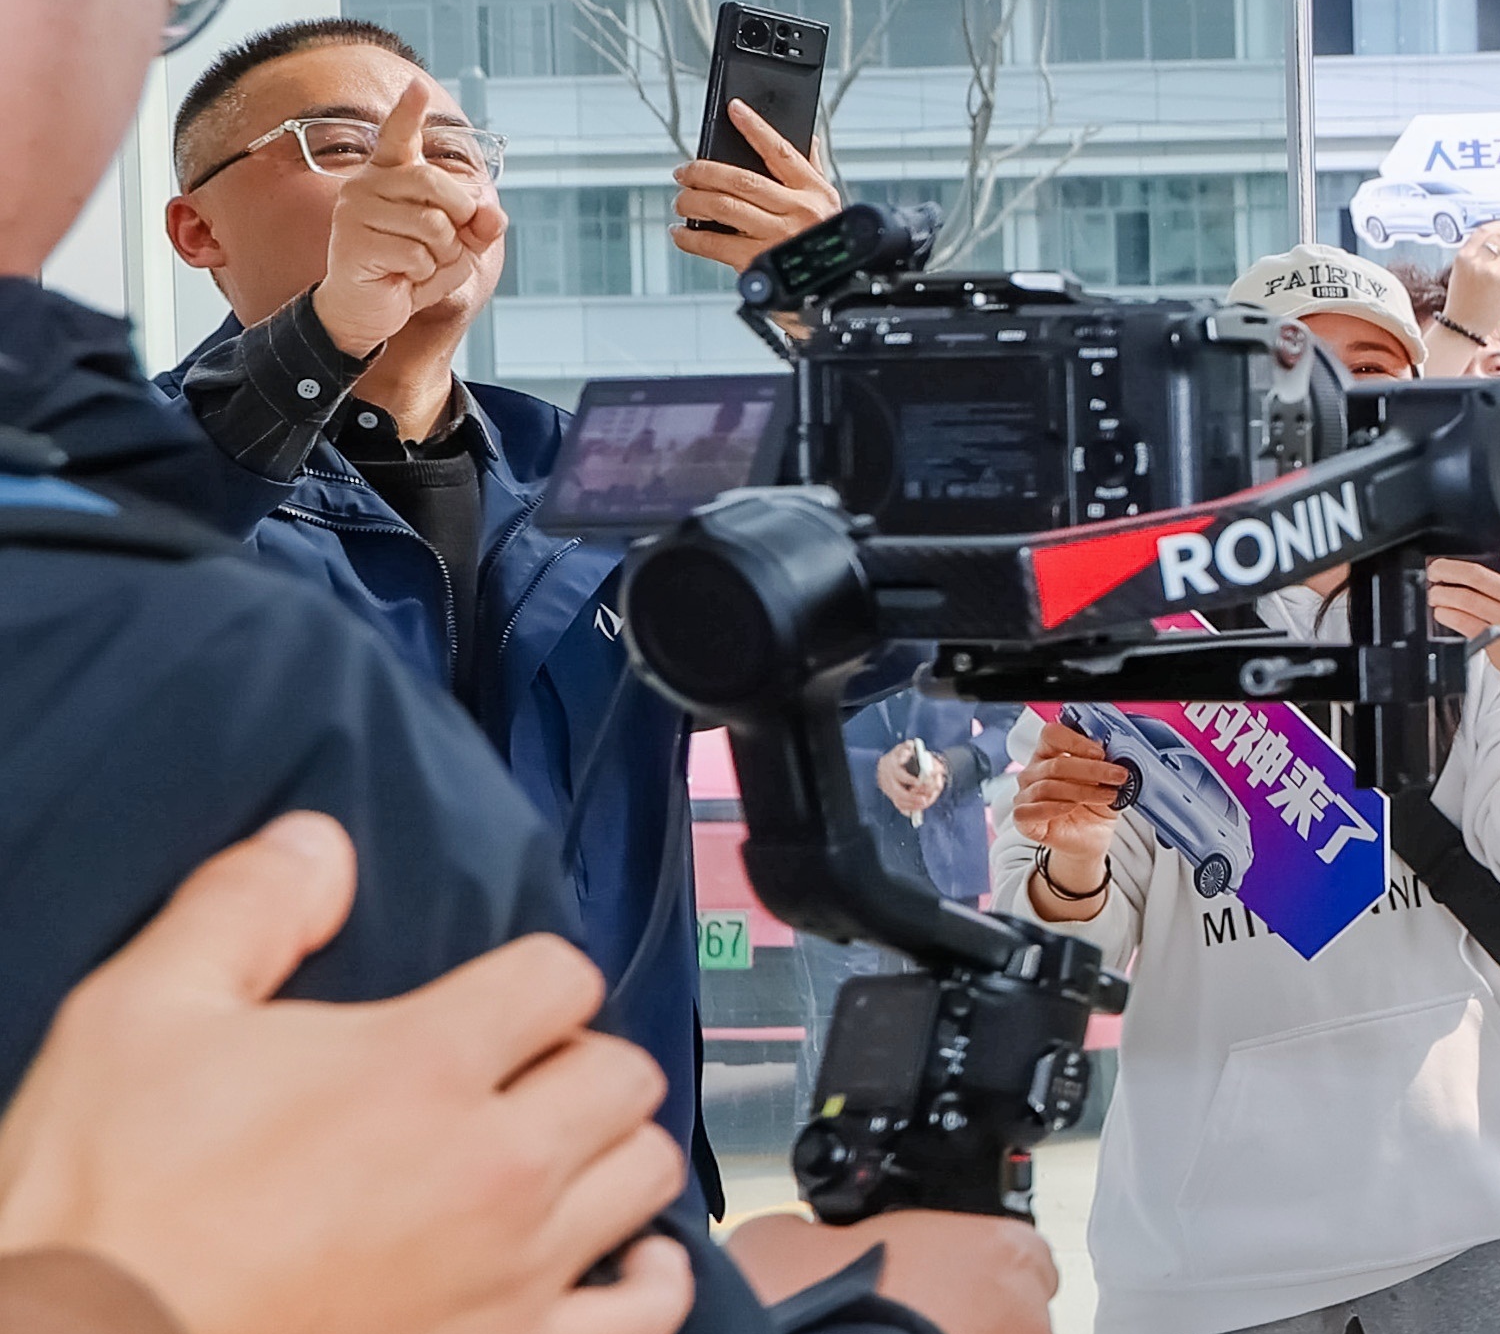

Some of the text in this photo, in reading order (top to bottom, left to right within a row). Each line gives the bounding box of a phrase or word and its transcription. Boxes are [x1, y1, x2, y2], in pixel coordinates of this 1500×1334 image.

[1264, 264, 1388, 302] FAIRLY
[1157, 481, 1363, 601] RONIN
[696, 920, 743, 958] 67
